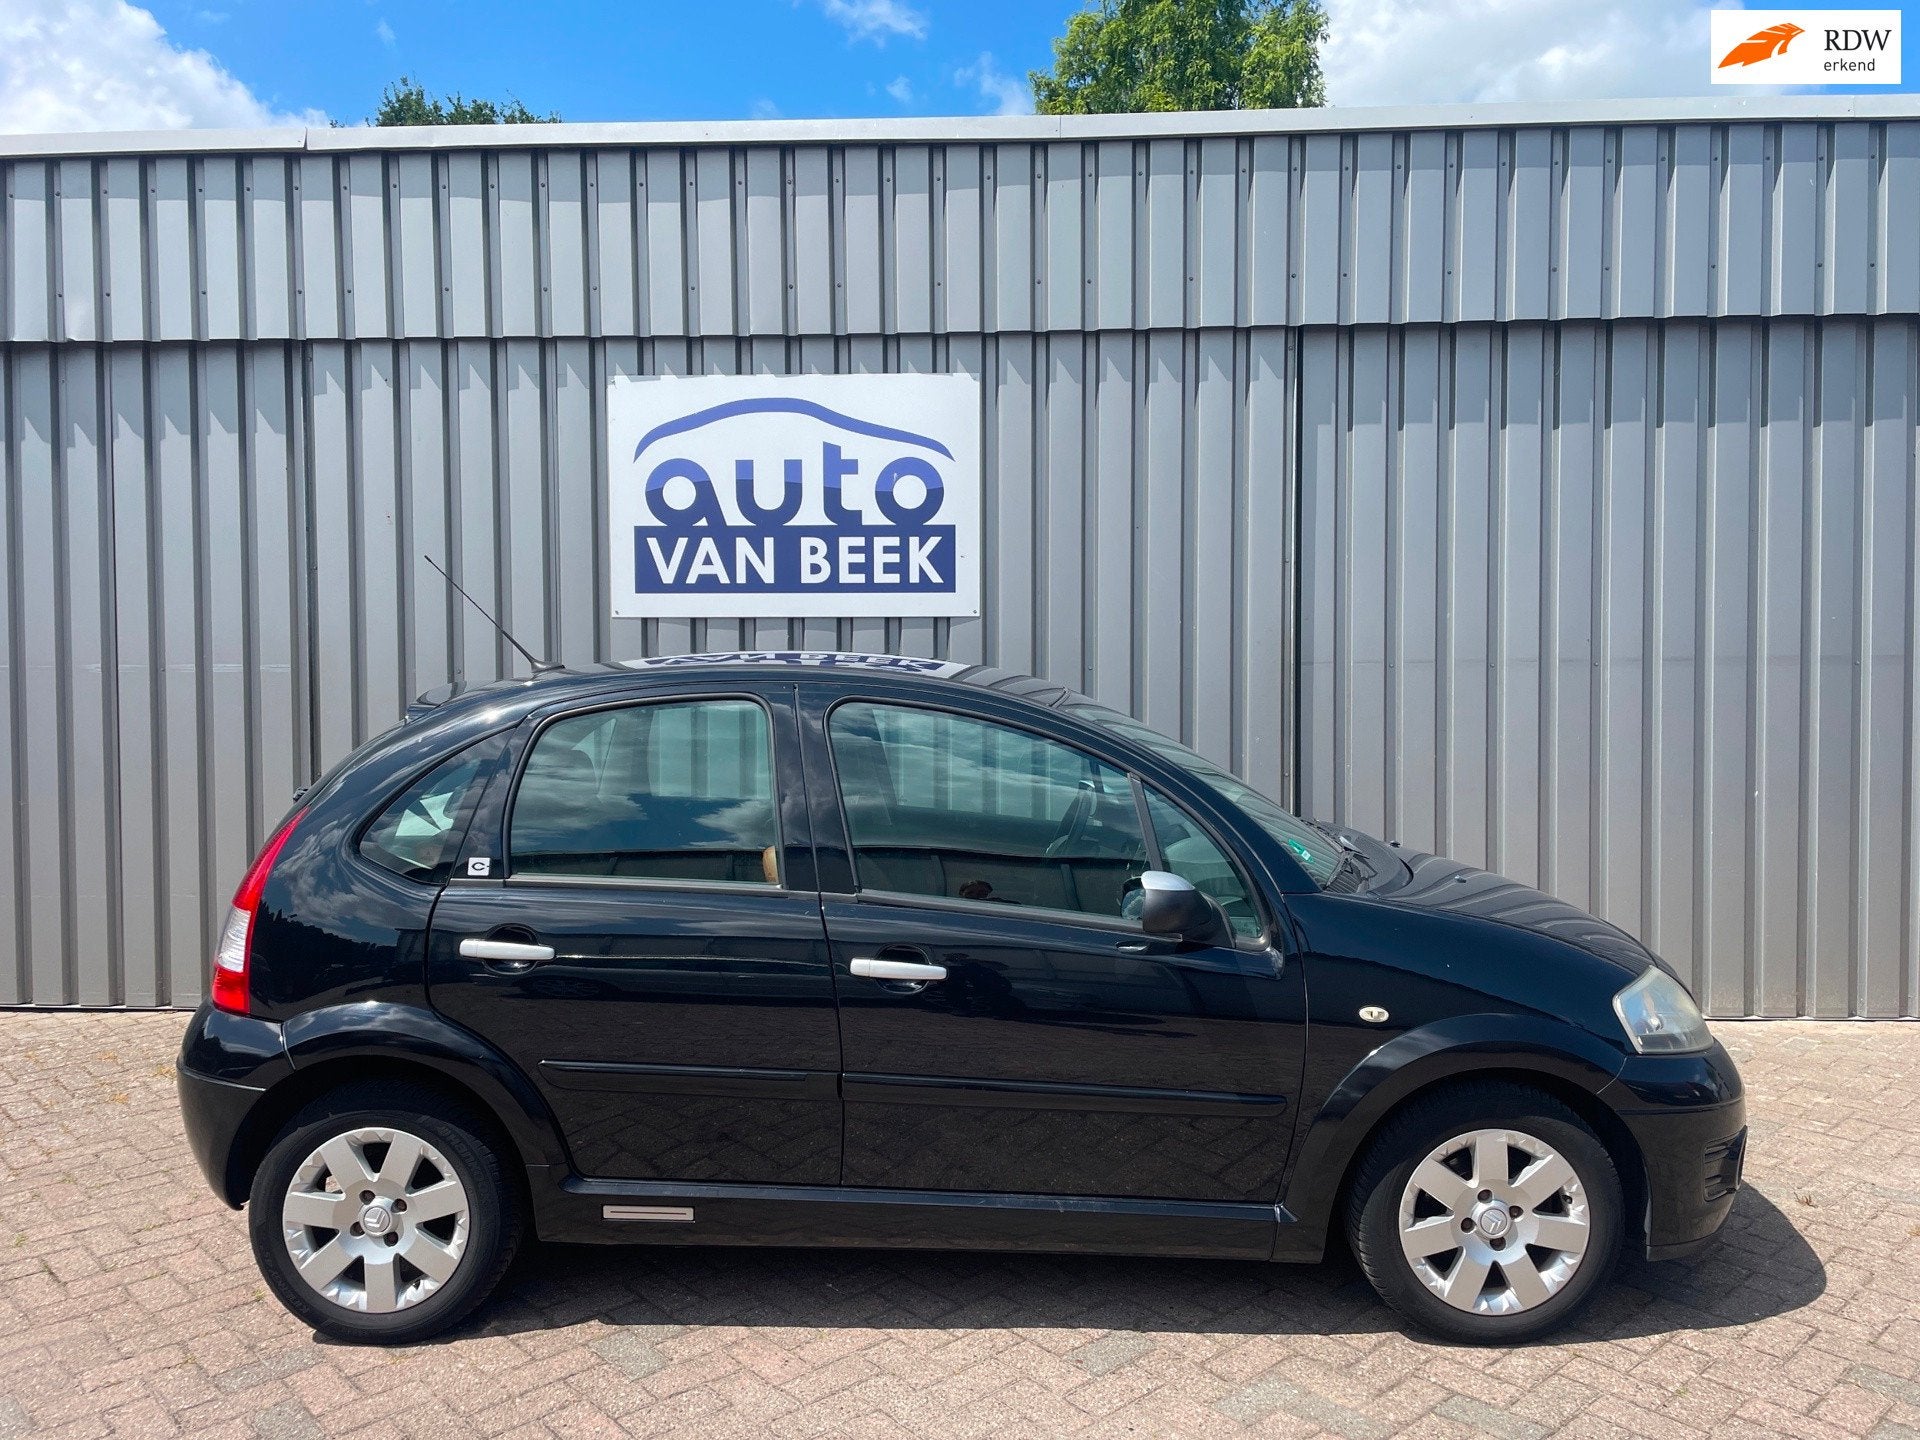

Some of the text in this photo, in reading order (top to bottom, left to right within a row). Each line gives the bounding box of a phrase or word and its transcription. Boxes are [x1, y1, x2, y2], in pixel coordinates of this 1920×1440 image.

[645, 441, 944, 526] auto
[646, 535, 945, 585] VAN BEEK
